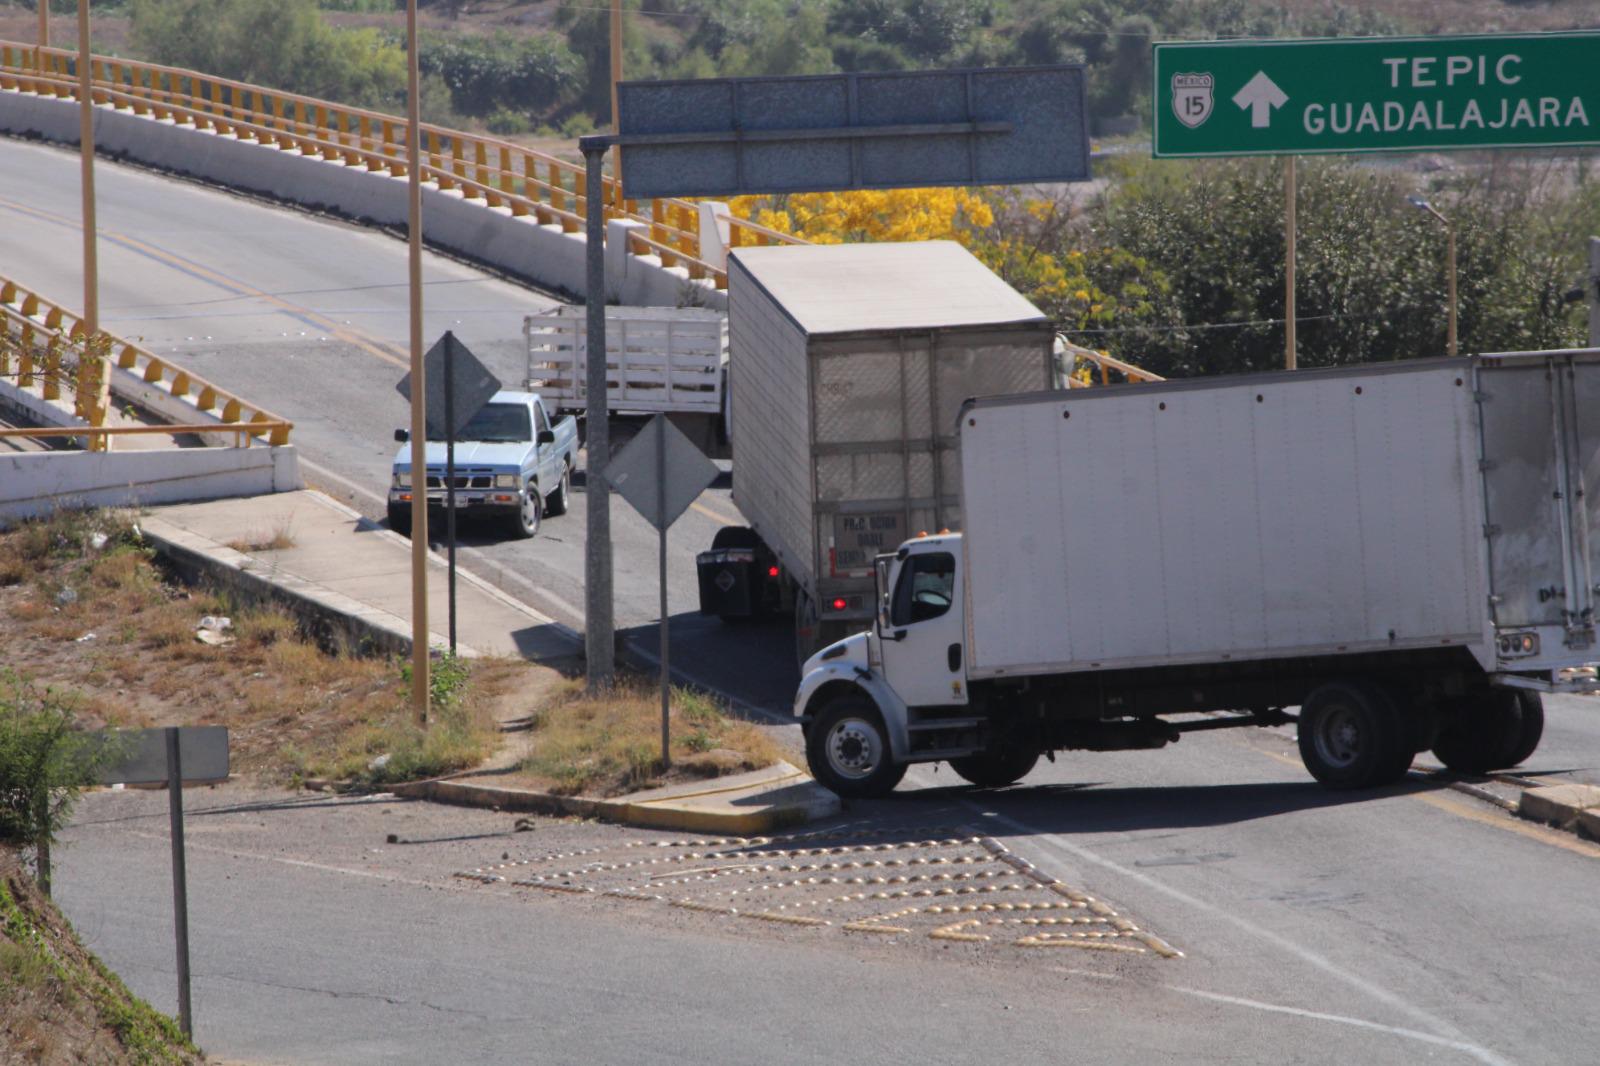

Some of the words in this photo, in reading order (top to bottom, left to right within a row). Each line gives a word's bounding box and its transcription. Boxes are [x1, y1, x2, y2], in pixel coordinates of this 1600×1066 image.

[1383, 55, 1523, 87] TEPIC
[1186, 96, 1204, 116] 15
[1303, 97, 1590, 135] GUADALAJARA
